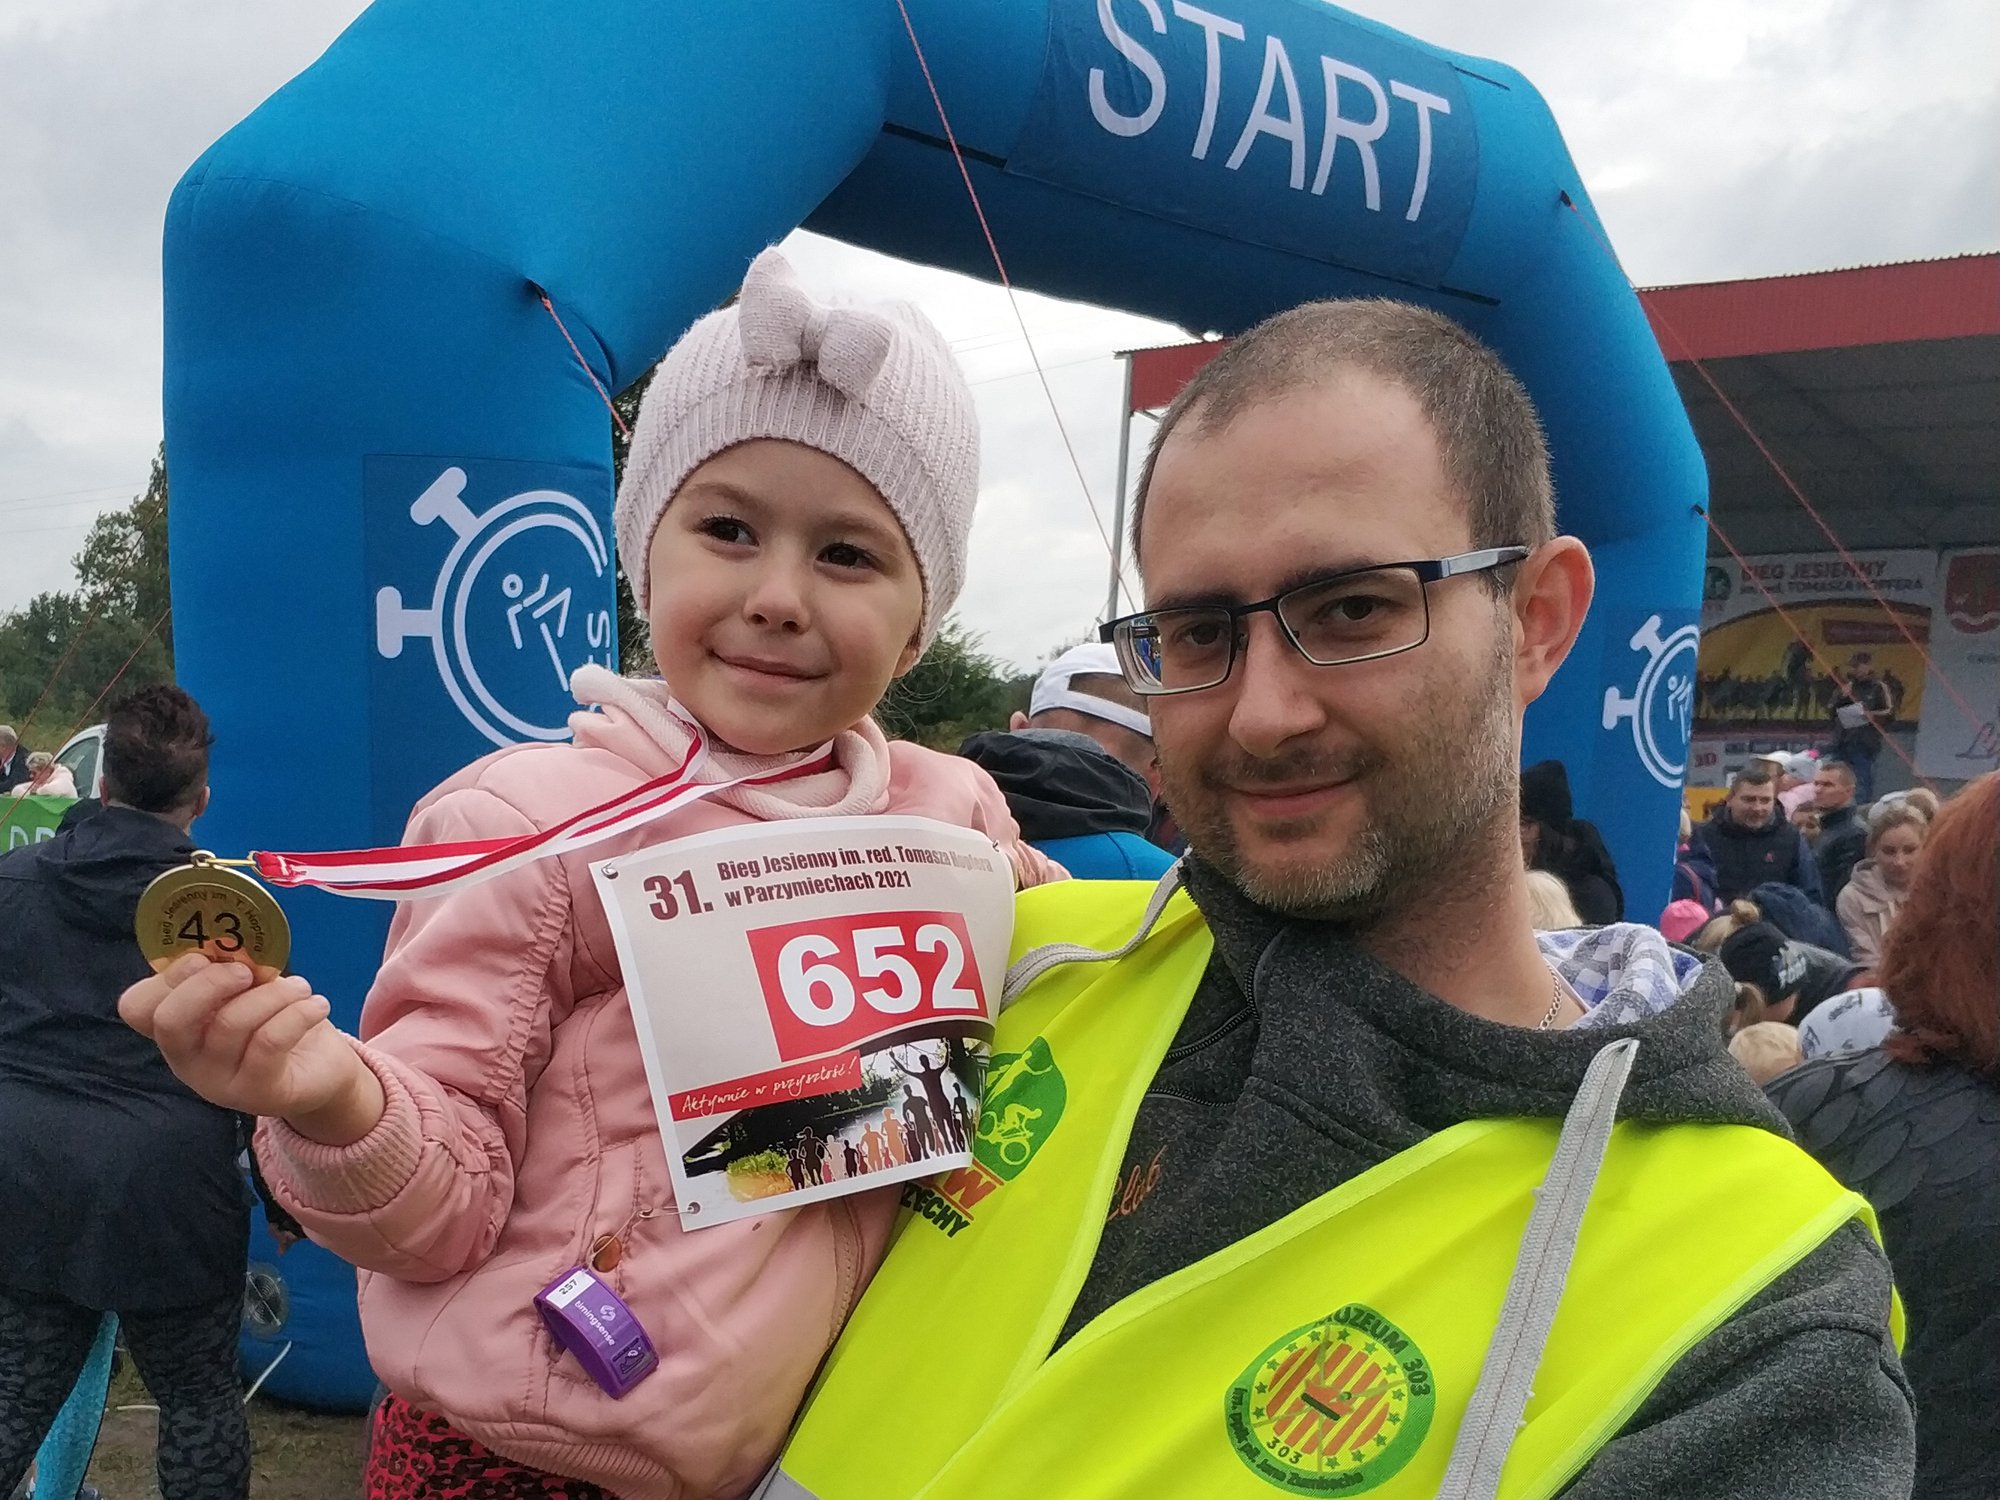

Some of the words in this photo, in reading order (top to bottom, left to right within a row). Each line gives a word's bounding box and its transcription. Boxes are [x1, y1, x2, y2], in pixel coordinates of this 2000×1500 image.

[1089, 0, 1451, 222] START
[717, 860, 761, 882] Bieg
[763, 850, 838, 875] Jesienny
[838, 848, 866, 867] im.
[867, 846, 896, 864] red.
[895, 845, 951, 866] Tomasza
[643, 869, 714, 921] 31.
[724, 890, 743, 908] w
[743, 872, 875, 905] Parzymiechach
[875, 870, 912, 889] 2021
[178, 910, 244, 952] 43
[777, 924, 979, 1026] 652
[682, 1087, 751, 1117] Aktywnie
[755, 1085, 768, 1096] w
[559, 1279, 578, 1295] 257
[574, 1300, 616, 1347] timingsense
[1403, 1358, 1431, 1397] 303
[1266, 1436, 1303, 1465] 303
